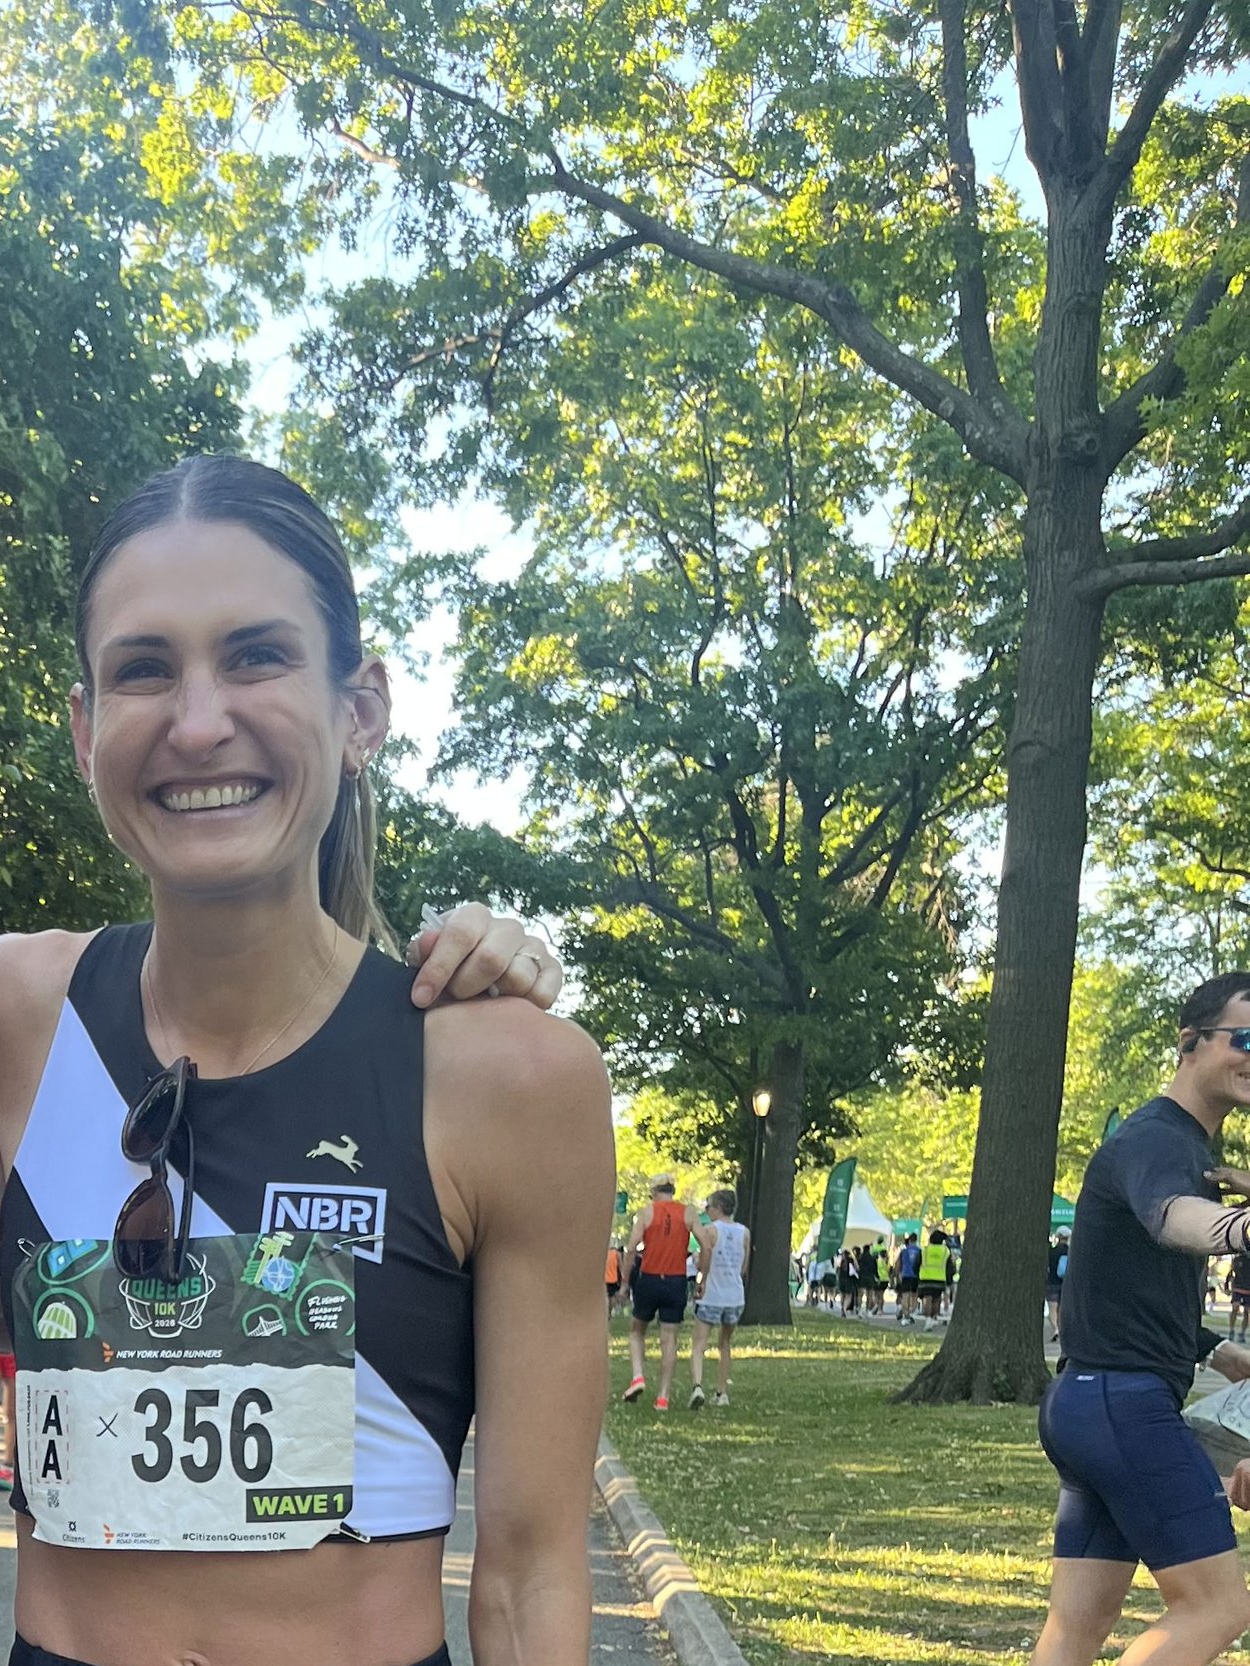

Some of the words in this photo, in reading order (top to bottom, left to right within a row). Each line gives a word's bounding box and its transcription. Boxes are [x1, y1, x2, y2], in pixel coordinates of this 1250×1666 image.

[274, 1196, 372, 1234] NBR
[131, 1277, 202, 1299] QUEENS
[154, 1302, 176, 1315] 10K
[116, 1350, 135, 1358] NEW
[136, 1350, 159, 1358] YORK
[160, 1350, 182, 1358] ROAD
[183, 1349, 223, 1358] RUNNERS
[130, 1388, 274, 1483] 356
[252, 1494, 328, 1516] WAVE
[333, 1493, 345, 1513] 1
[182, 1532, 286, 1541] #CitizensQueens10K
